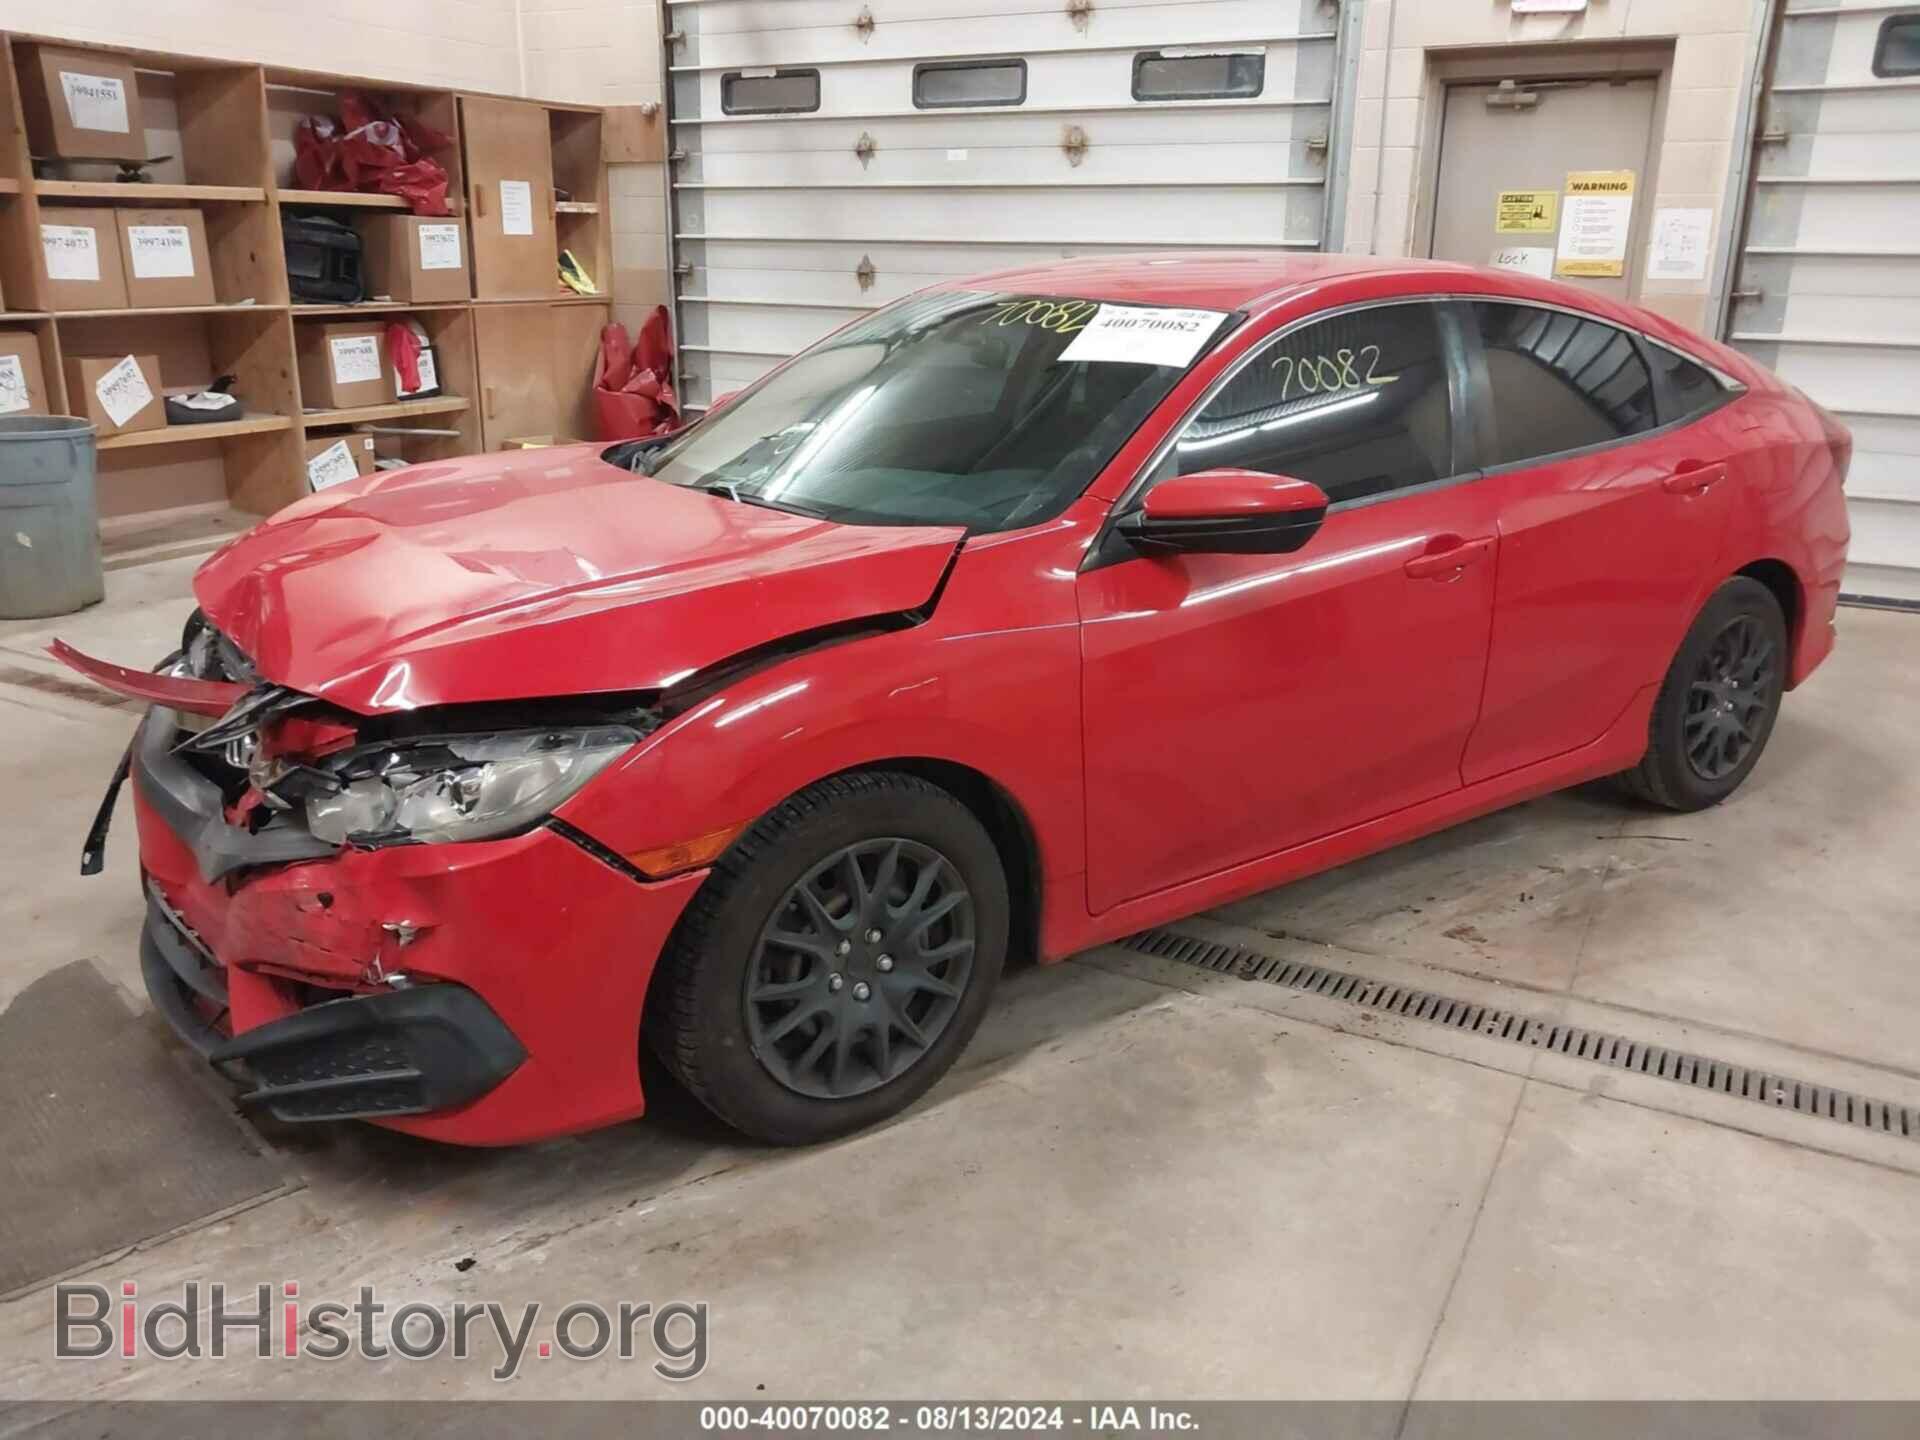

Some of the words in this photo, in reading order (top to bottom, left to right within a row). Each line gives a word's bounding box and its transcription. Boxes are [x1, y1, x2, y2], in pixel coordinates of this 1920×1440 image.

[1571, 181, 1629, 192] WARNING
[1100, 318, 1201, 333] 40070082
[1271, 344, 1400, 401] 70082
